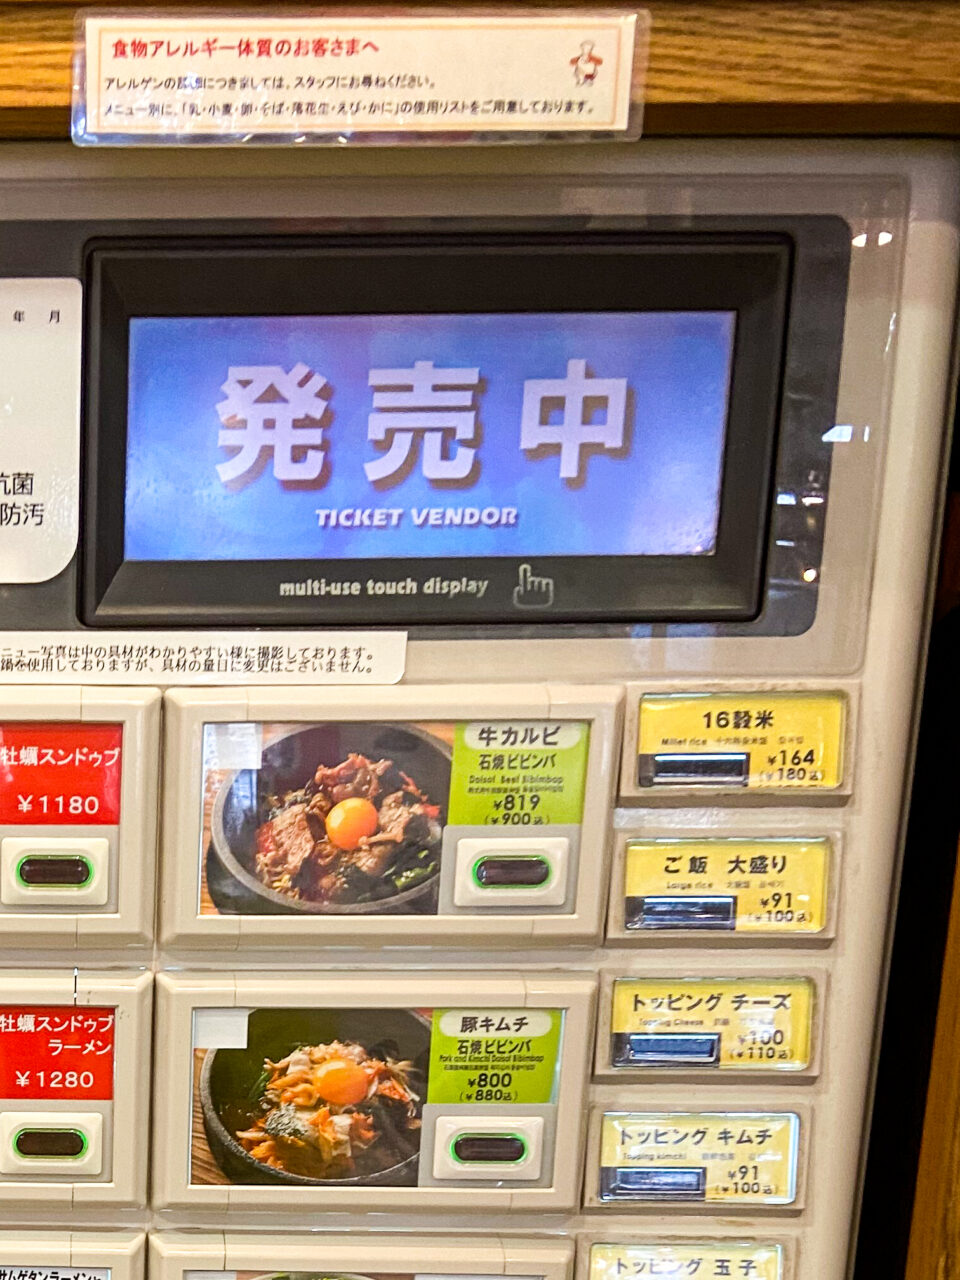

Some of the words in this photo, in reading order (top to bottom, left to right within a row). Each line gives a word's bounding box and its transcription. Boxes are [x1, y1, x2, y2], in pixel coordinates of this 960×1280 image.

[112, 37, 380, 59] 食物アレルギー体質のお客さまへ
[215, 358, 631, 486] 発売中
[315, 507, 403, 528] TICKET
[411, 507, 518, 528] VENDOR
[279, 577, 362, 597] multi-use
[367, 577, 418, 596] touch
[423, 575, 489, 599] display
[703, 710, 774, 730] 16穀米
[478, 726, 561, 747] 牛カルビ
[0, 746, 121, 768] 牡蠣スンドゥブ
[478, 753, 557, 770] 石焼ビビンバ
[767, 749, 816, 766] ¥164
[17, 795, 100, 814] ¥1180
[494, 795, 541, 811] ¥819
[663, 855, 709, 875] ご飯
[727, 855, 787, 875] 大盛り
[760, 892, 793, 909] ¥91
[633, 993, 723, 1011] トッピング
[731, 993, 792, 1011] チーズ
[460, 1016, 529, 1033] 豚キムチ
[48, 1039, 112, 1056] ラーメン
[457, 1039, 532, 1055] 石焼ビビンバ
[15, 1071, 95, 1088] ¥1280
[468, 1073, 512, 1088] ¥800
[621, 1127, 709, 1145] トッピング
[717, 1128, 773, 1145] キムチ
[728, 1165, 759, 1181] ¥91
[713, 1258, 757, 1276] 玉子
